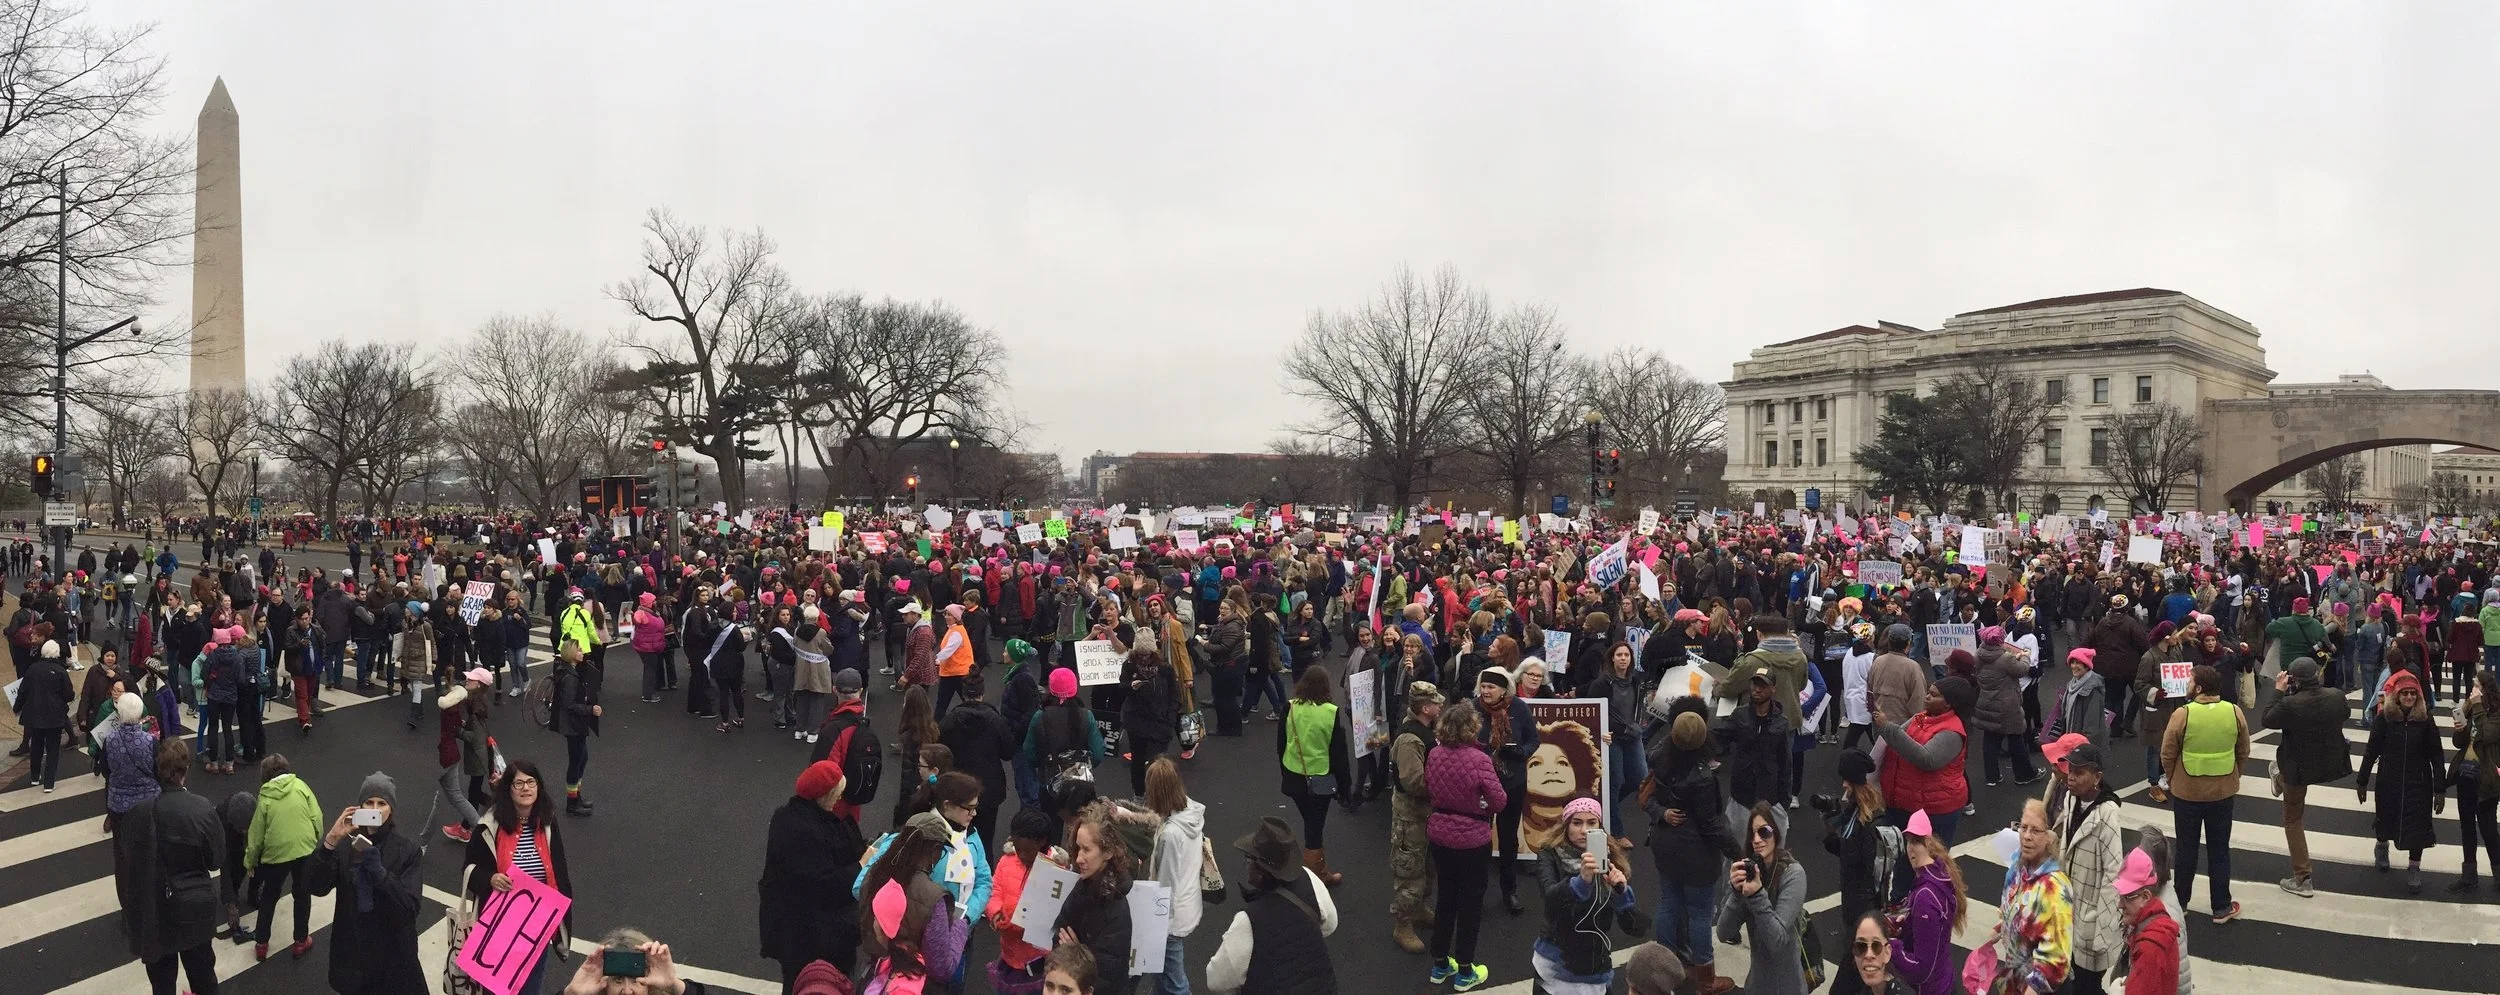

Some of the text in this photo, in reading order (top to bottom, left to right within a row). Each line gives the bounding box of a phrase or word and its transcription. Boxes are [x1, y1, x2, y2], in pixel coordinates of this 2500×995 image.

[2406, 526, 2422, 538] Liar
[1596, 556, 1625, 589] SILENT
[1860, 571, 1876, 583] TAKE
[465, 581, 495, 598] PUSSY
[1951, 626, 1975, 636] LONGER
[1082, 659, 1103, 667] YOUR
[1080, 672, 1100, 681] WORD
[2162, 664, 2191, 679] FREE
[1532, 706, 1596, 718] ARE PERFECT
